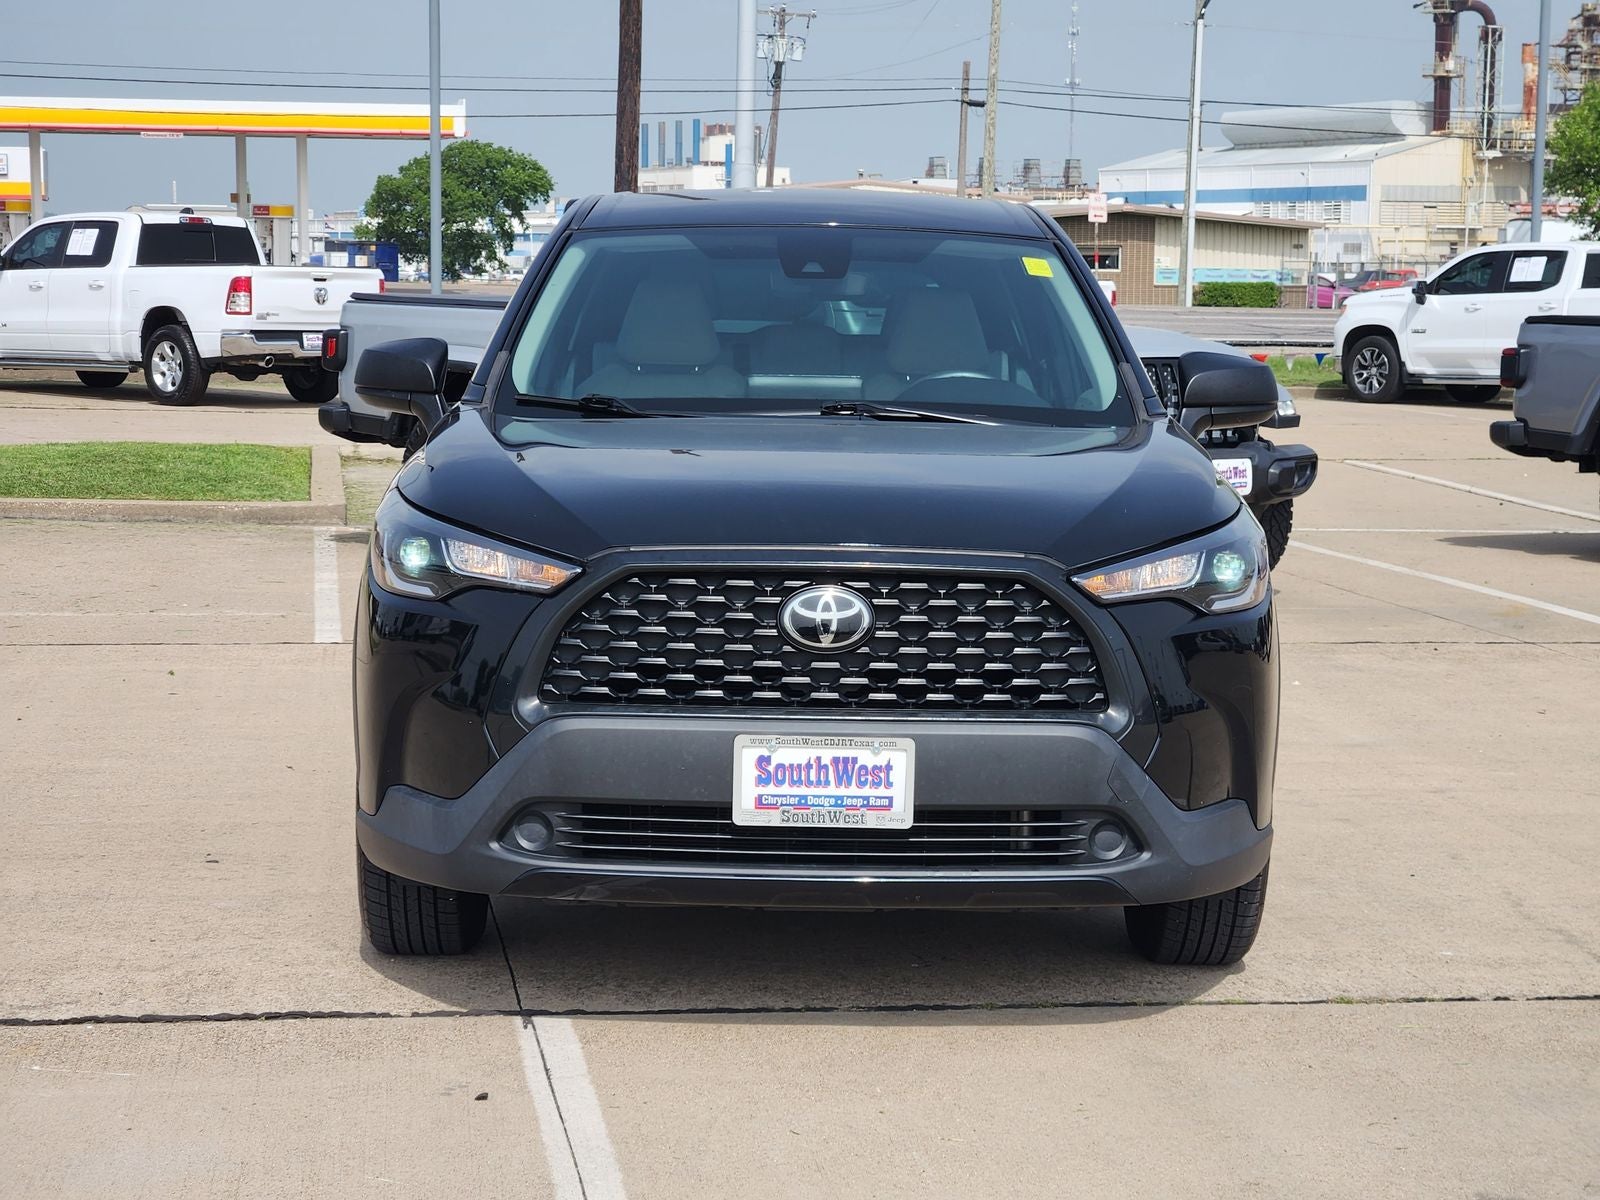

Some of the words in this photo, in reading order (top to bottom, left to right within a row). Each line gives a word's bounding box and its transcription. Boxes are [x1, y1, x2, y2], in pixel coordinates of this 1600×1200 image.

[749, 737, 897, 748] wwwSouthWestCDJRTexascom
[755, 754, 894, 789] SouthWest
[761, 795, 800, 806] Chrysler
[807, 796, 836, 806] Dodge
[842, 796, 863, 806] Jeep
[869, 796, 889, 806] Ram
[781, 810, 866, 824] SouthWest
